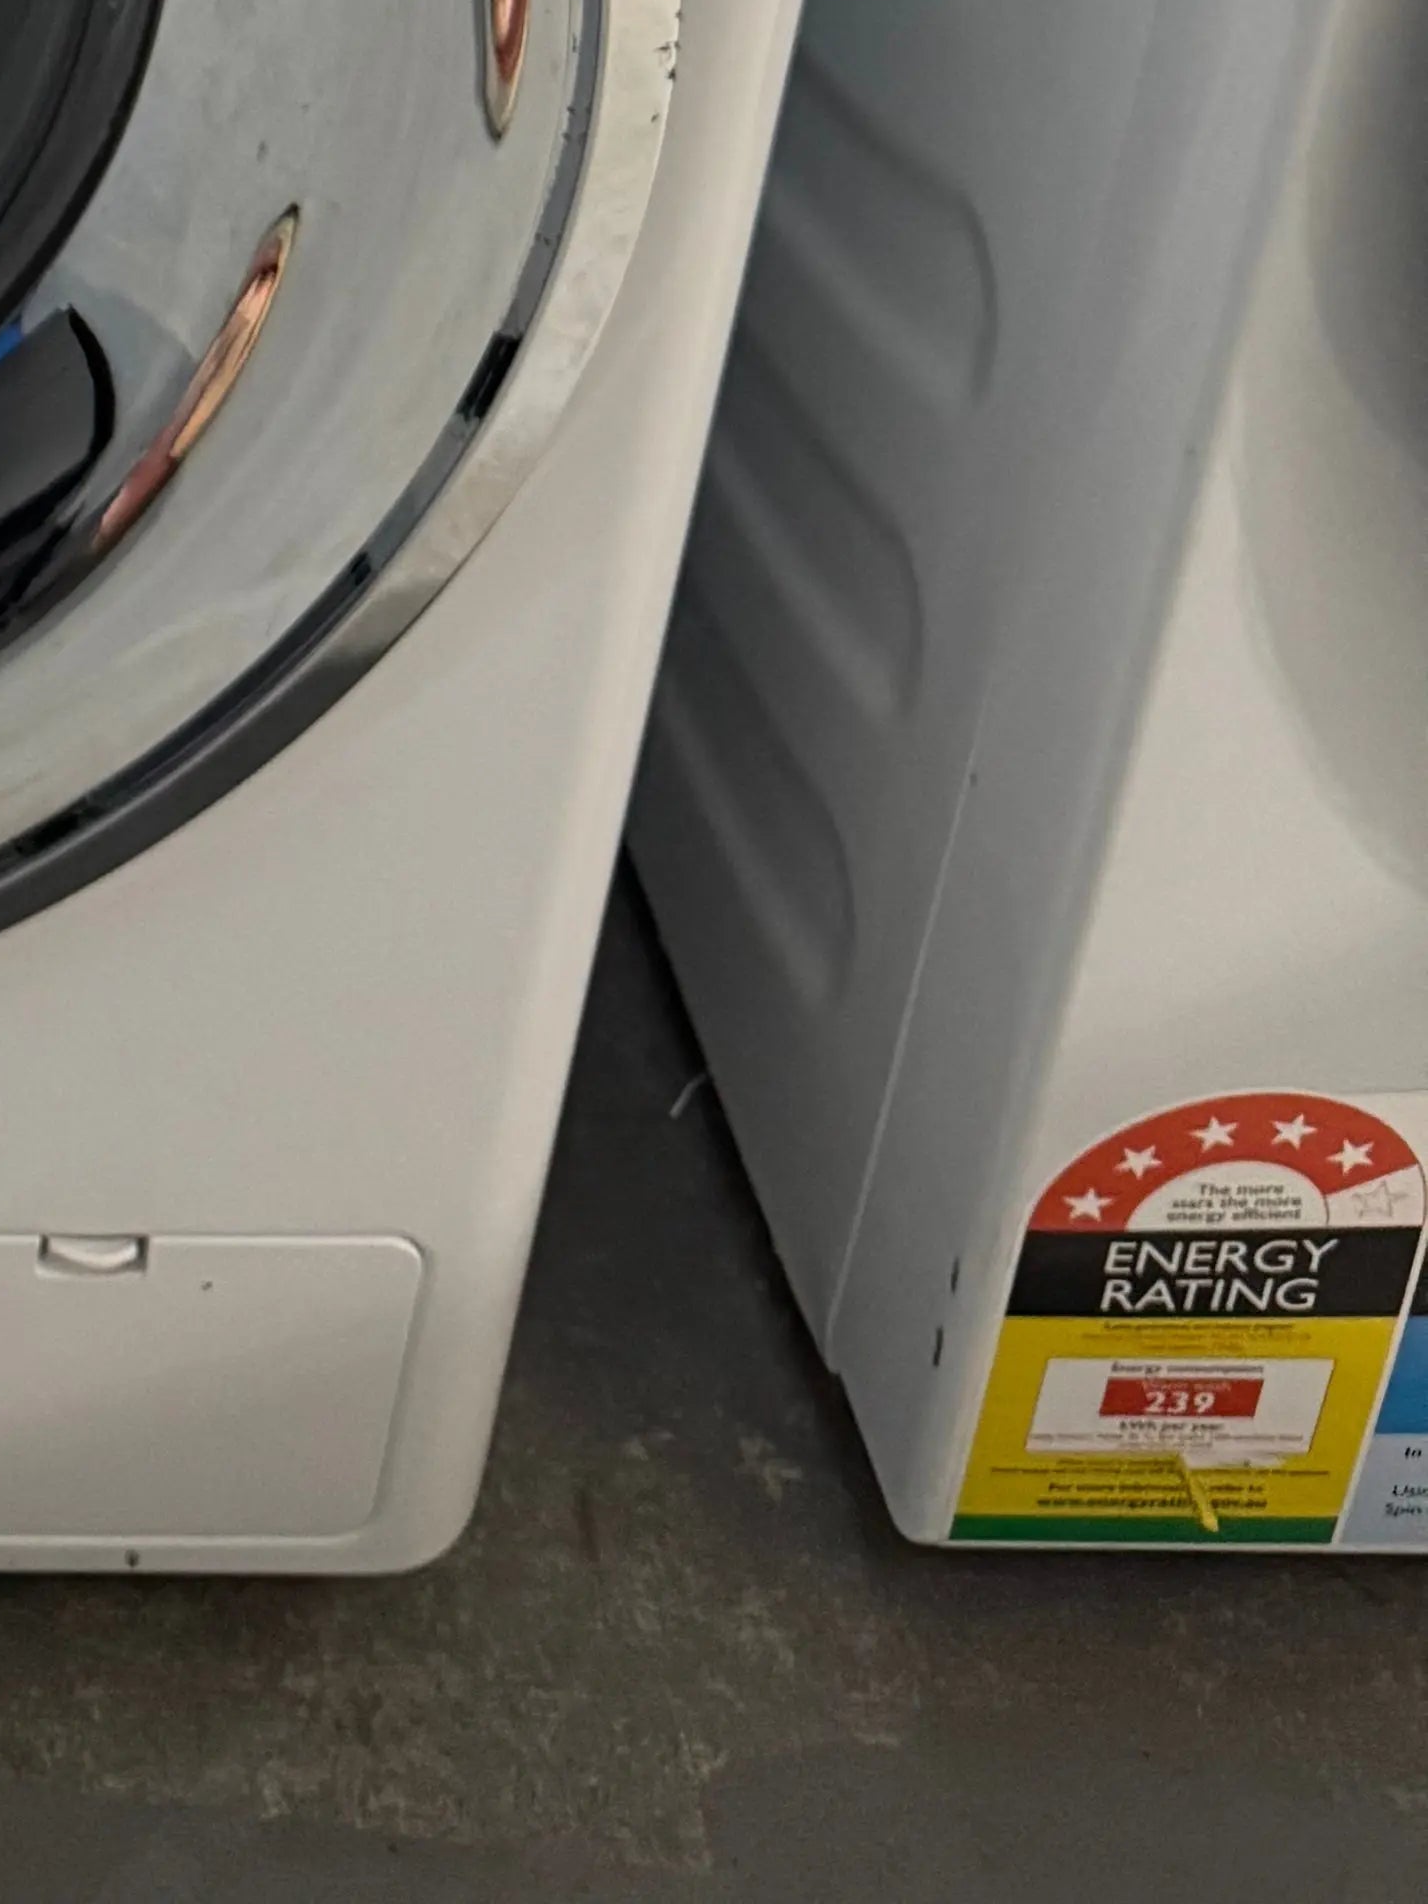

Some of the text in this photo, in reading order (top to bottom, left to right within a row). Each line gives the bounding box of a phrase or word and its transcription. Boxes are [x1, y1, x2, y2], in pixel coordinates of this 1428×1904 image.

[1103, 1239, 1339, 1274] ENERGY
[1100, 1278, 1321, 1311] RATING
[1145, 1391, 1216, 1414] 239
